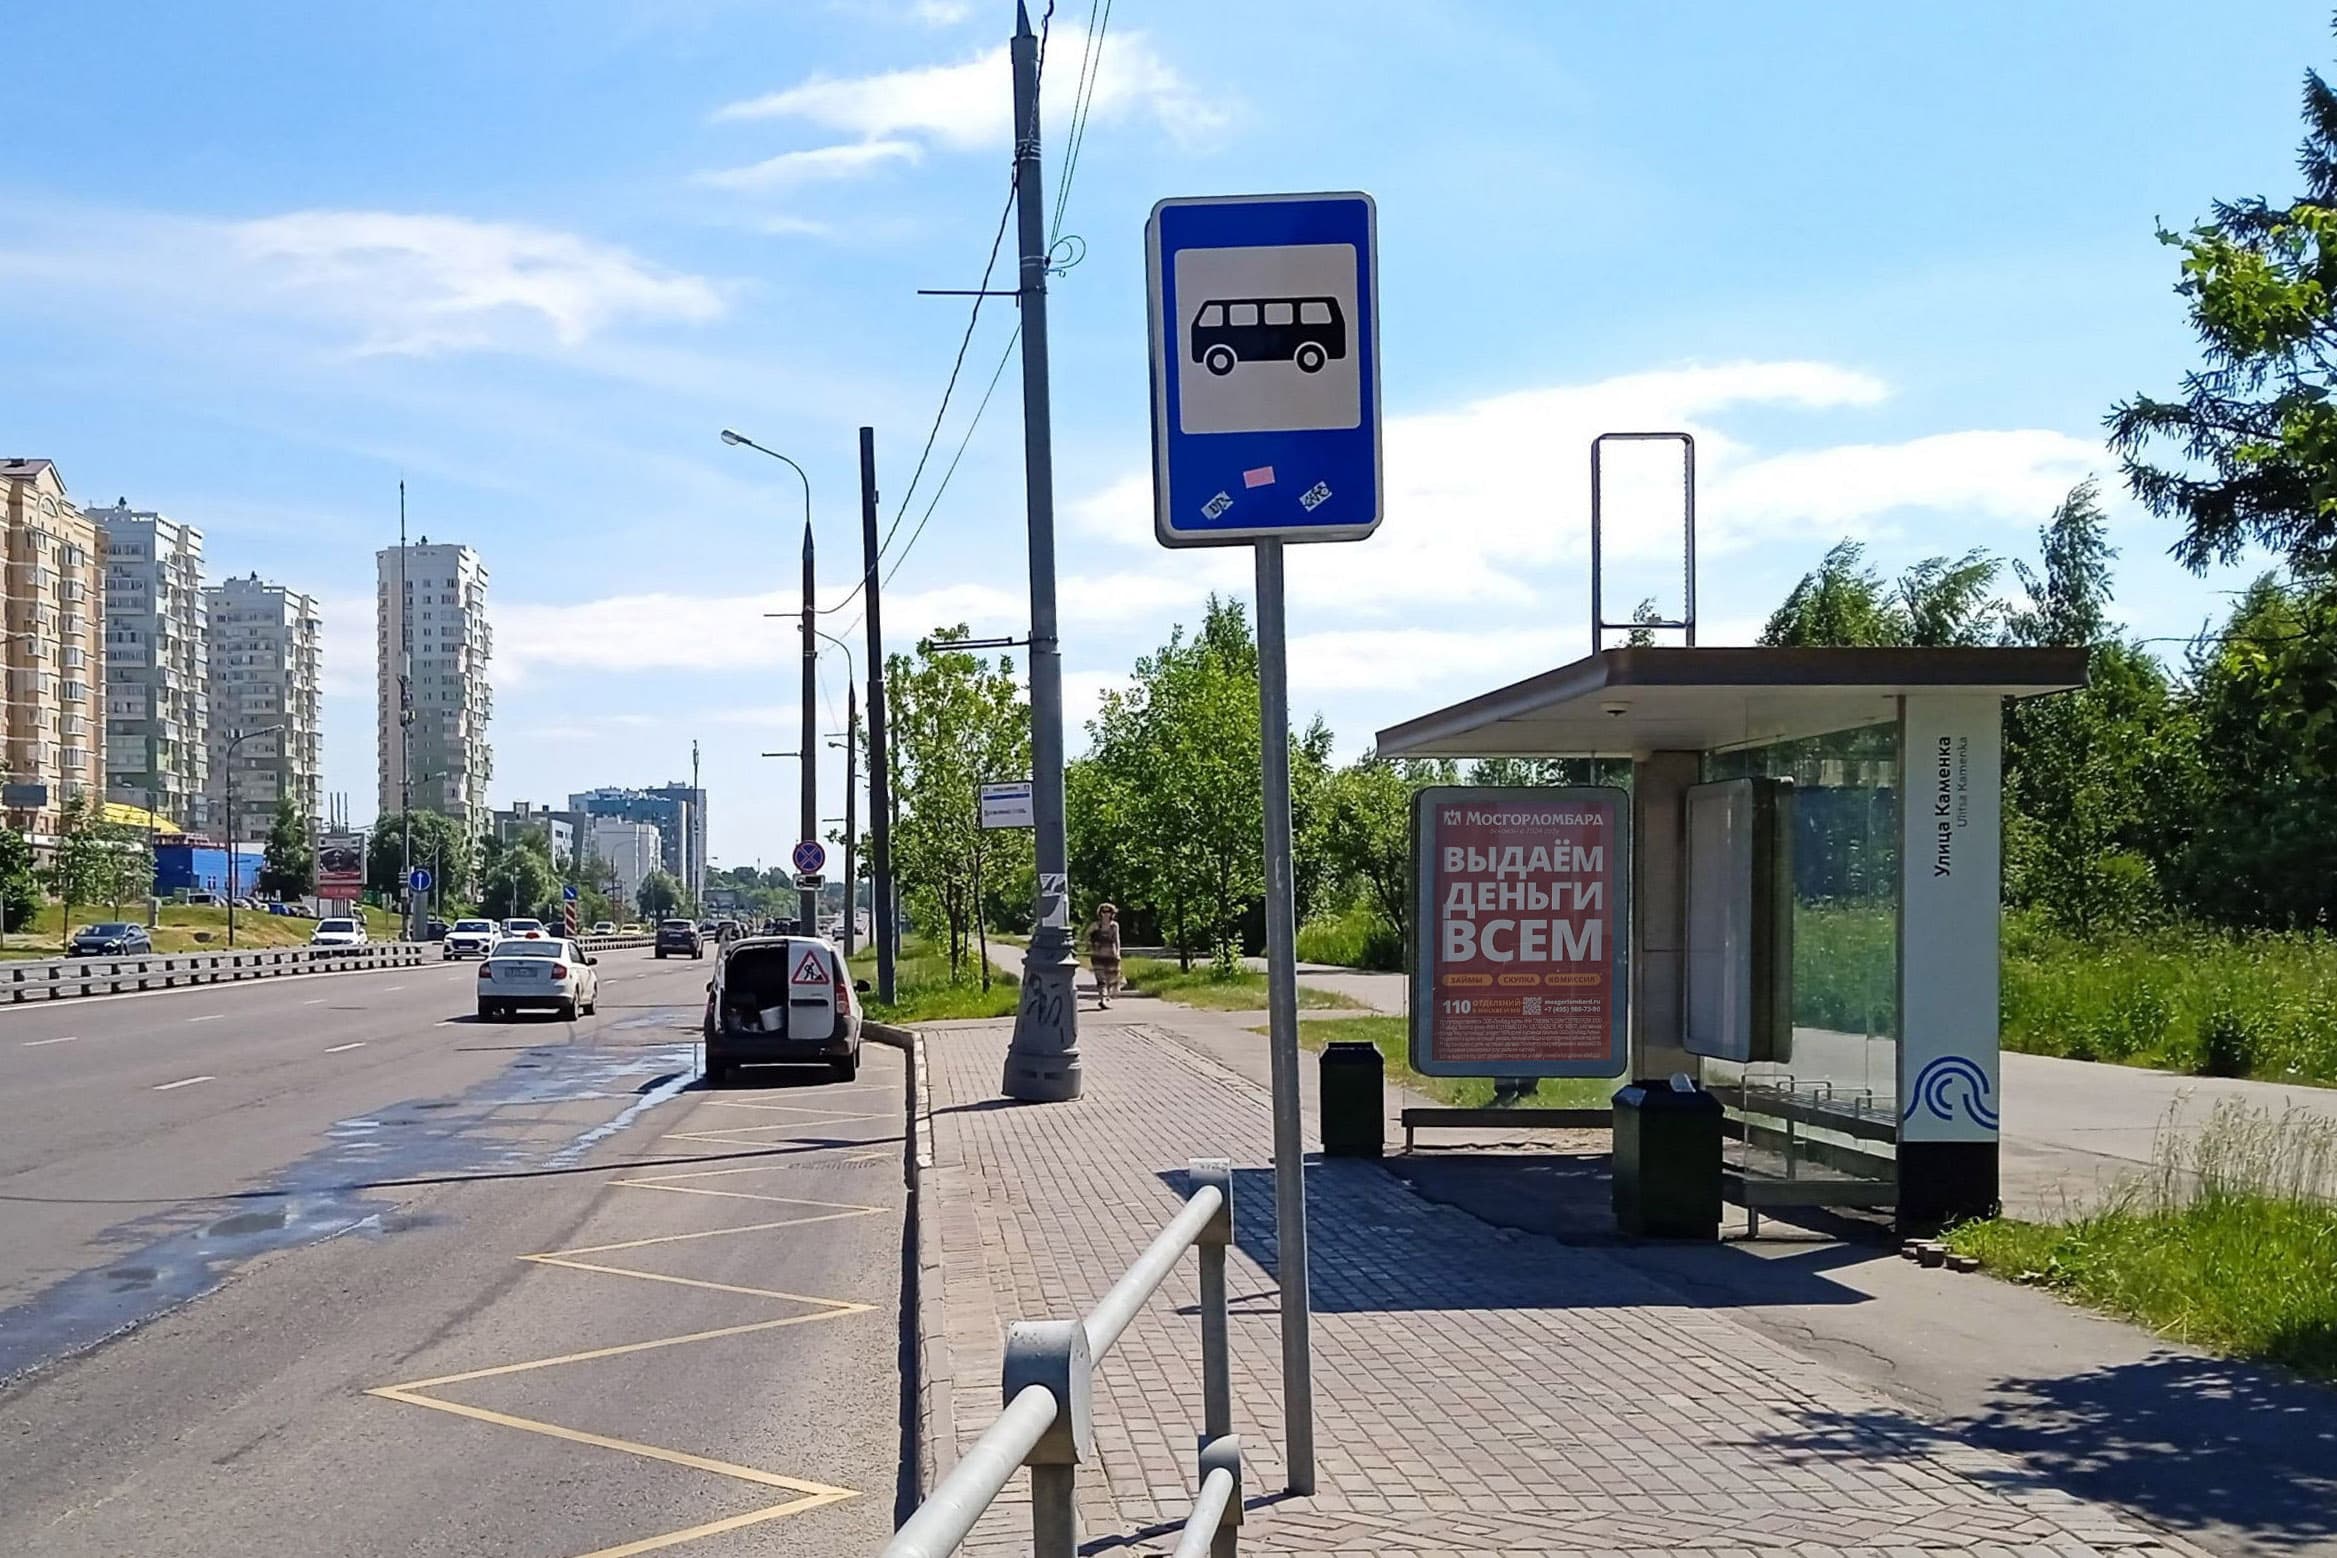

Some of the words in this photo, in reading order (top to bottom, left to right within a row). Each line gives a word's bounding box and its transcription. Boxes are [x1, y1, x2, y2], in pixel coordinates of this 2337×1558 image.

[1935, 736, 1952, 817] Каменка
[1957, 736, 1968, 791] Kamenka
[1443, 839, 1604, 880] ВЫДАЁМ
[1934, 822, 1952, 877] Улица
[1443, 882, 1604, 919] ДЕНЬГИ
[1442, 919, 1603, 963] ВСЕМ
[1503, 975, 1536, 984] СКУПКА
[1443, 1000, 1472, 1015] 110
